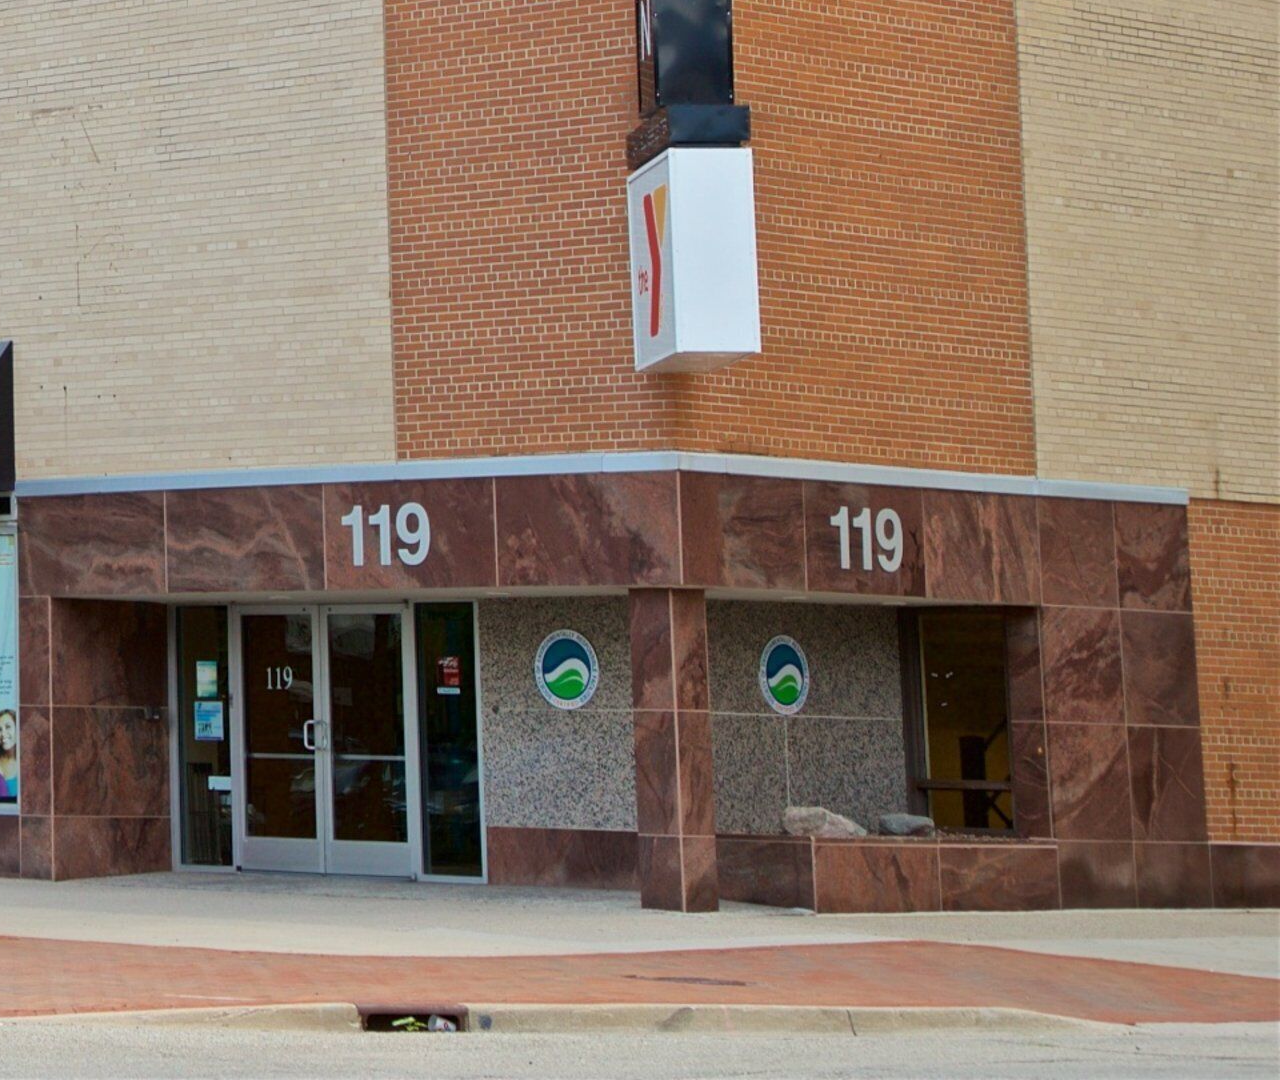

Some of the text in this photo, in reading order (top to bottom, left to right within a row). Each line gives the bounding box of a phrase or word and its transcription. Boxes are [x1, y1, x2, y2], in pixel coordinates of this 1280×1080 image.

[341, 502, 431, 567] 119
[830, 506, 904, 573] 119
[266, 666, 293, 690] 119
